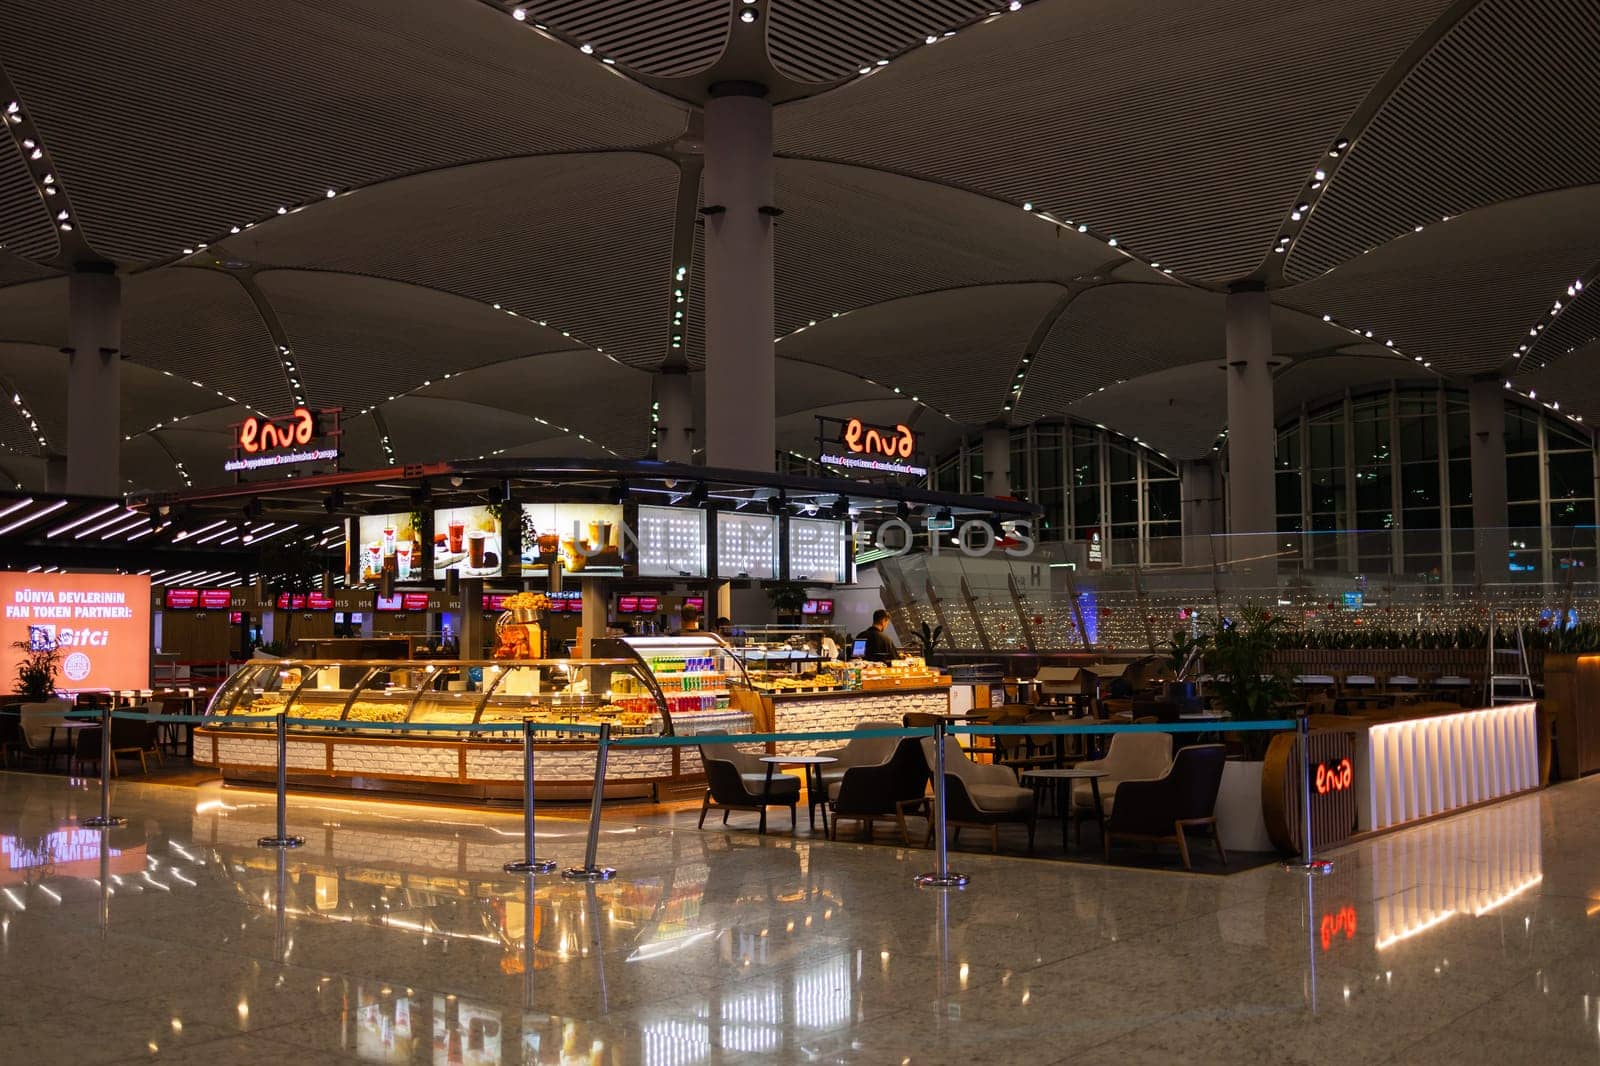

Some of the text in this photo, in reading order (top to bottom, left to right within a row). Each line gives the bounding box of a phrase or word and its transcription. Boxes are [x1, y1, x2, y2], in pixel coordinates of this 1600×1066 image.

[15, 589, 55, 603] DÜNYA
[231, 598, 247, 607] H17
[335, 600, 349, 608] H15
[358, 600, 373, 609] H14
[428, 601, 441, 609] H13
[6, 606, 30, 618] FAN
[33, 606, 71, 618] TOKEN
